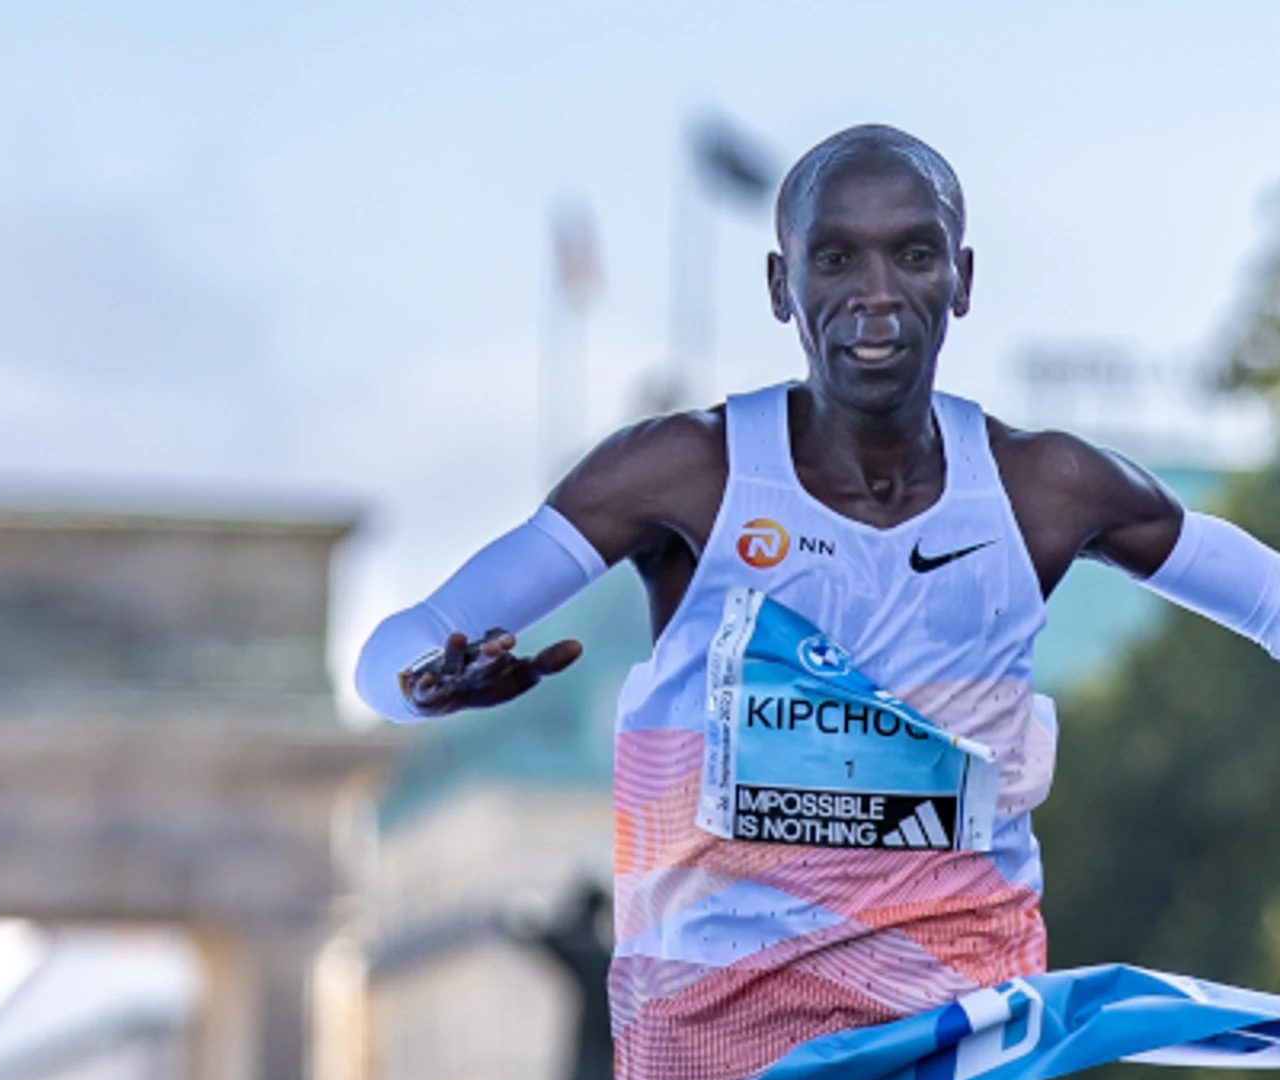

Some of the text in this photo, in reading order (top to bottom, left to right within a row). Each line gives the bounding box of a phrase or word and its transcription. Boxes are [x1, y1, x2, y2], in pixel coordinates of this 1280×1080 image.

[799, 536, 836, 557] NN
[844, 760, 855, 779] 1
[738, 788, 886, 820] IMPOSSIBLE
[737, 813, 878, 846] IS NOTHING
